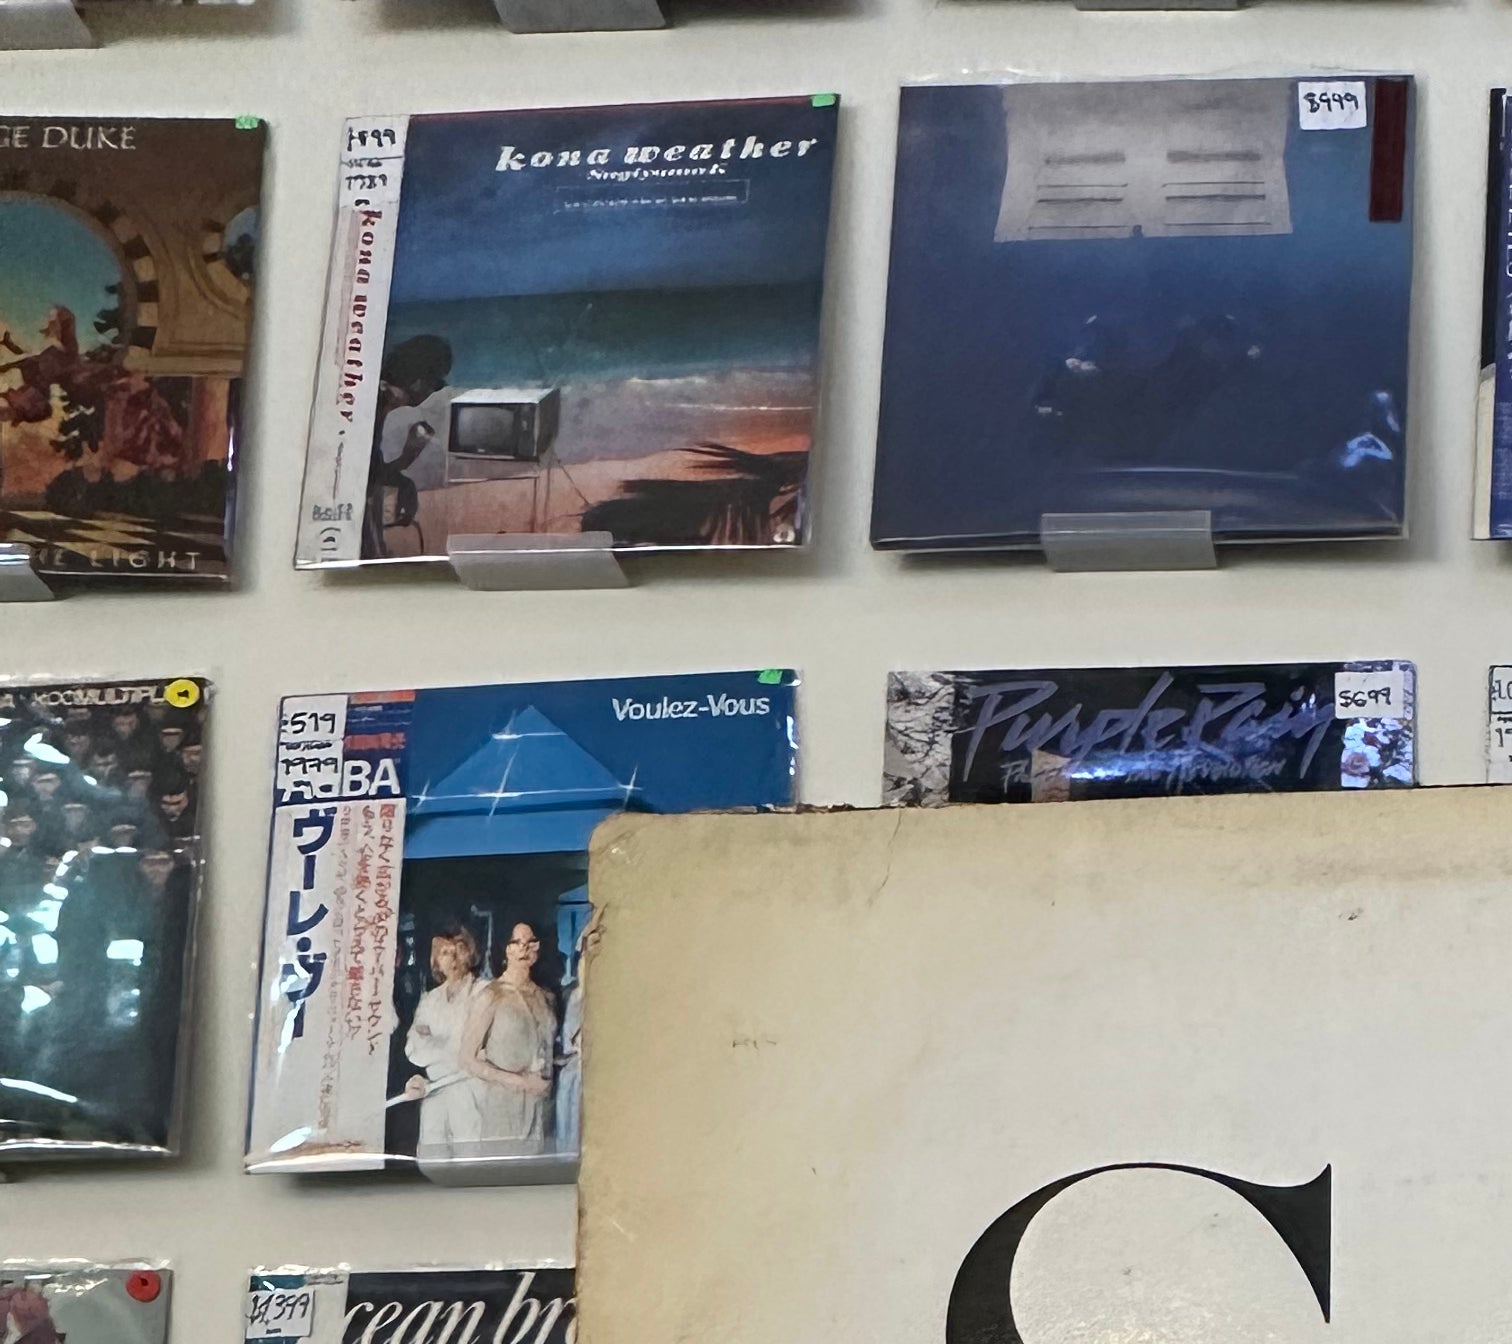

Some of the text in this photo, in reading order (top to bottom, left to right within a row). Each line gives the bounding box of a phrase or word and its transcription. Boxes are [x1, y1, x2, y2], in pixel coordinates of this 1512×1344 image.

[42, 126, 136, 150] DUKE
[495, 145, 612, 172] kona
[622, 135, 818, 165] weather
[340, 209, 383, 424] kona weather
[90, 551, 201, 571] LIGHT
[611, 692, 771, 721] Voulez-Vous
[953, 670, 1188, 782] Purple
